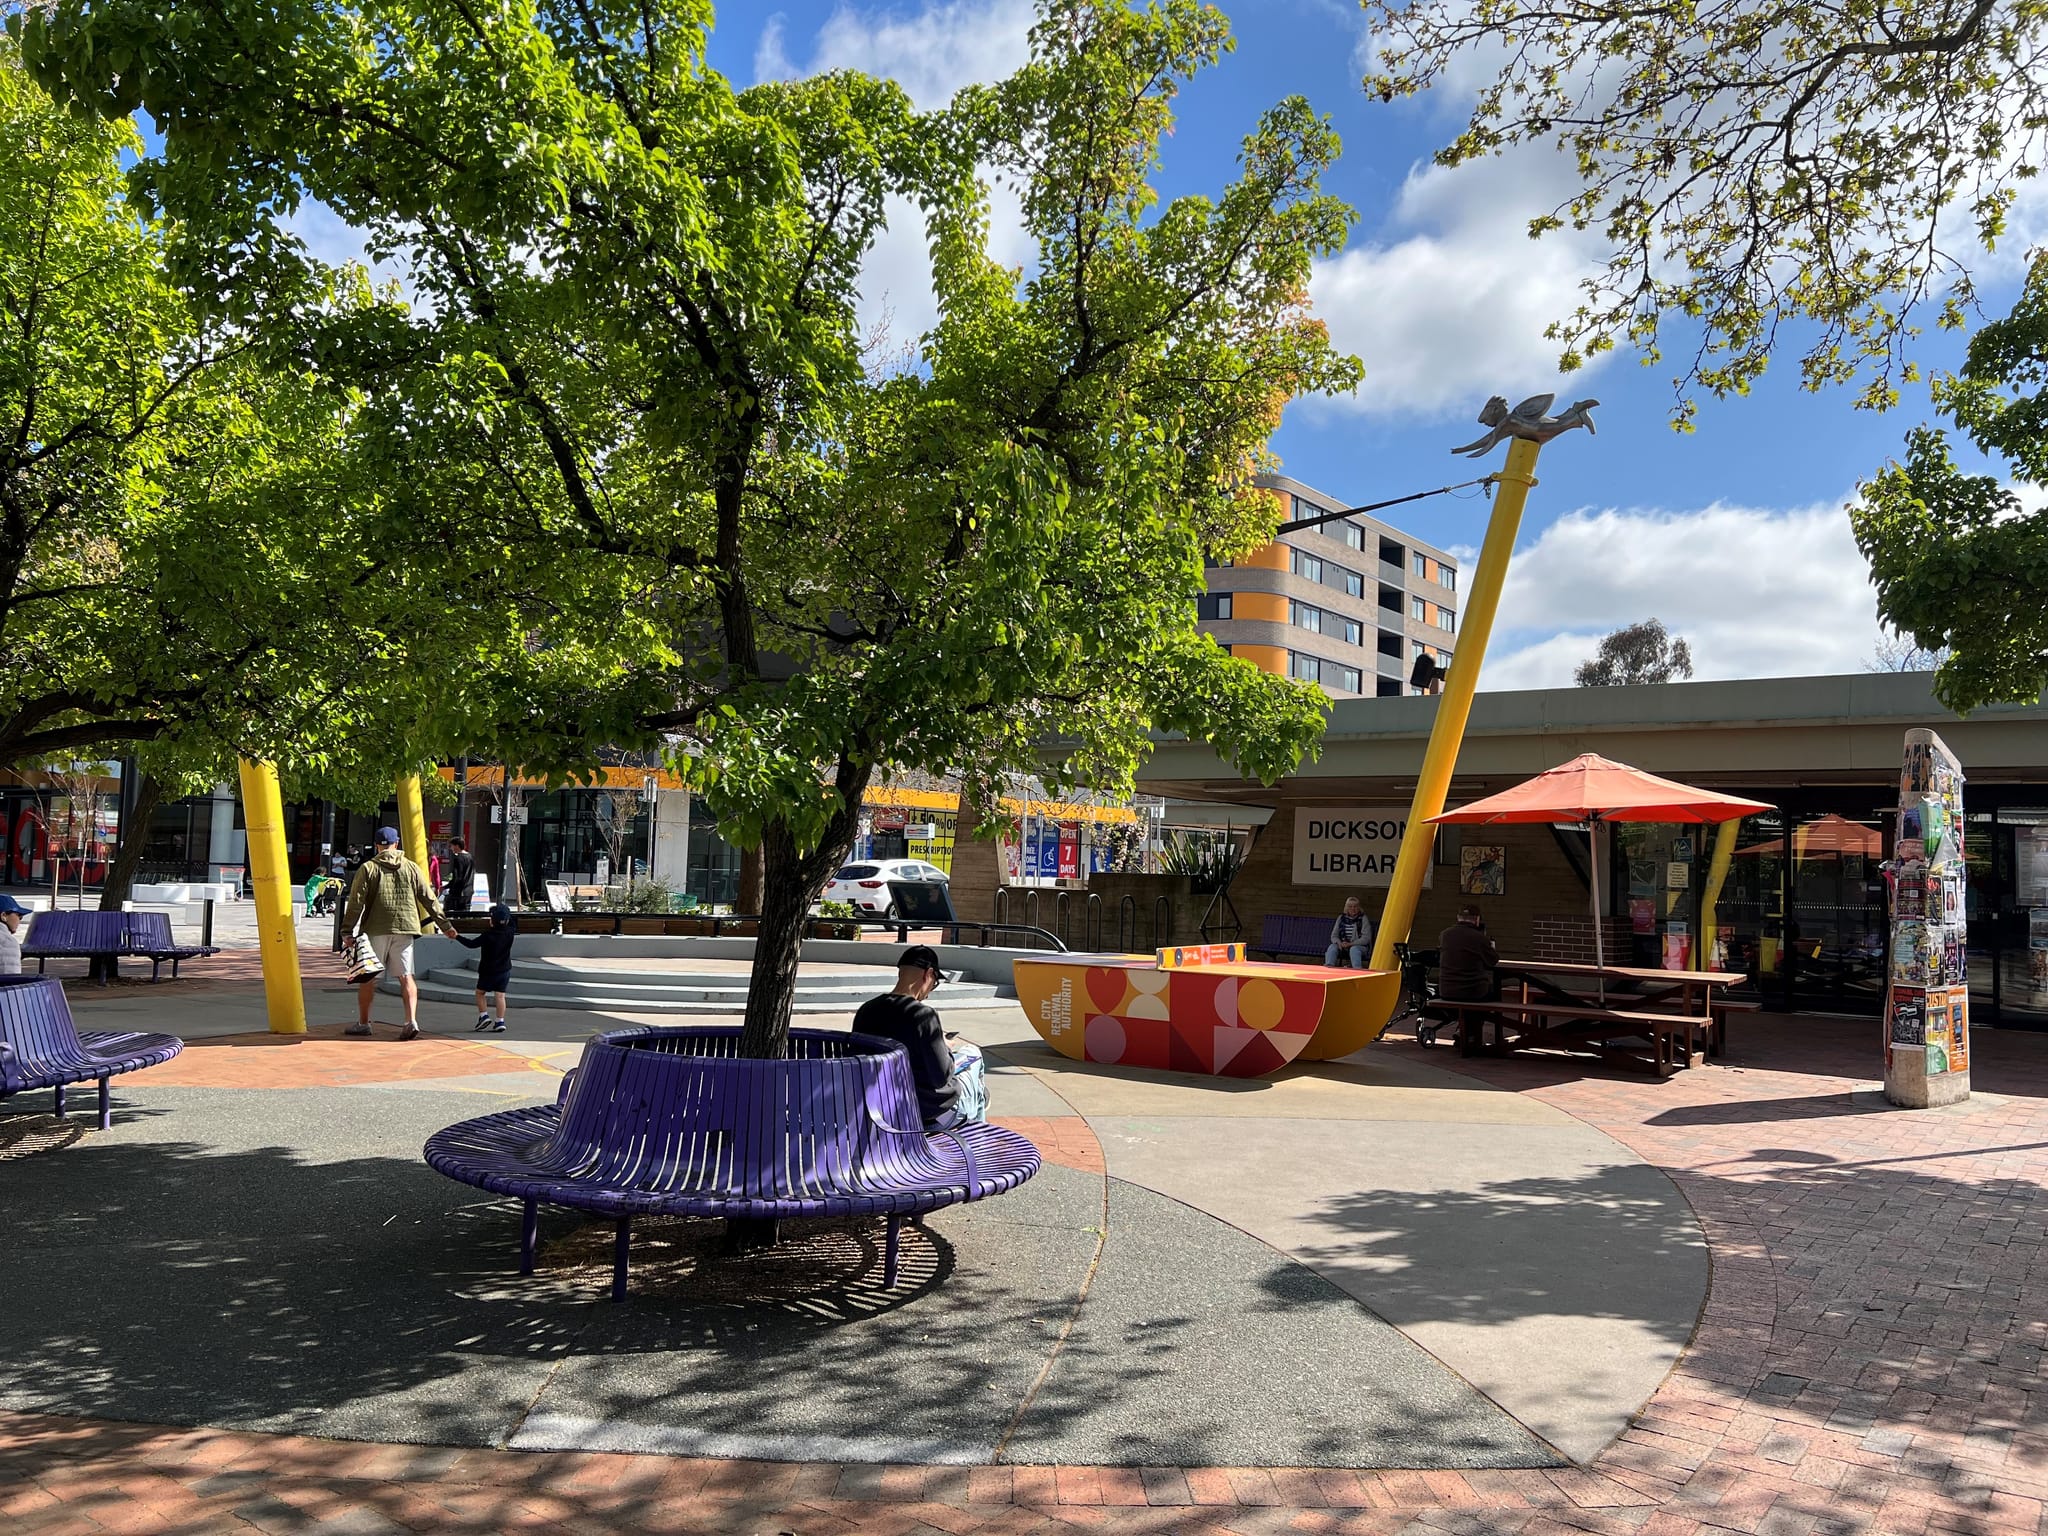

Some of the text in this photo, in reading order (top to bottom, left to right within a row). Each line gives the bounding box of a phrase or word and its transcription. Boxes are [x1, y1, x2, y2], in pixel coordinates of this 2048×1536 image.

[1060, 829, 1077, 839] OPEN
[910, 845, 953, 856] PRESCRIPTIO
[1065, 845, 1072, 861] 7
[1060, 864, 1076, 874] DAYS
[1309, 853, 1399, 874] LIBRAR
[1041, 999, 1051, 1020] CITY
[1061, 977, 1072, 1030] AUTHORITY
[1051, 992, 1061, 1036] RENEWAL
